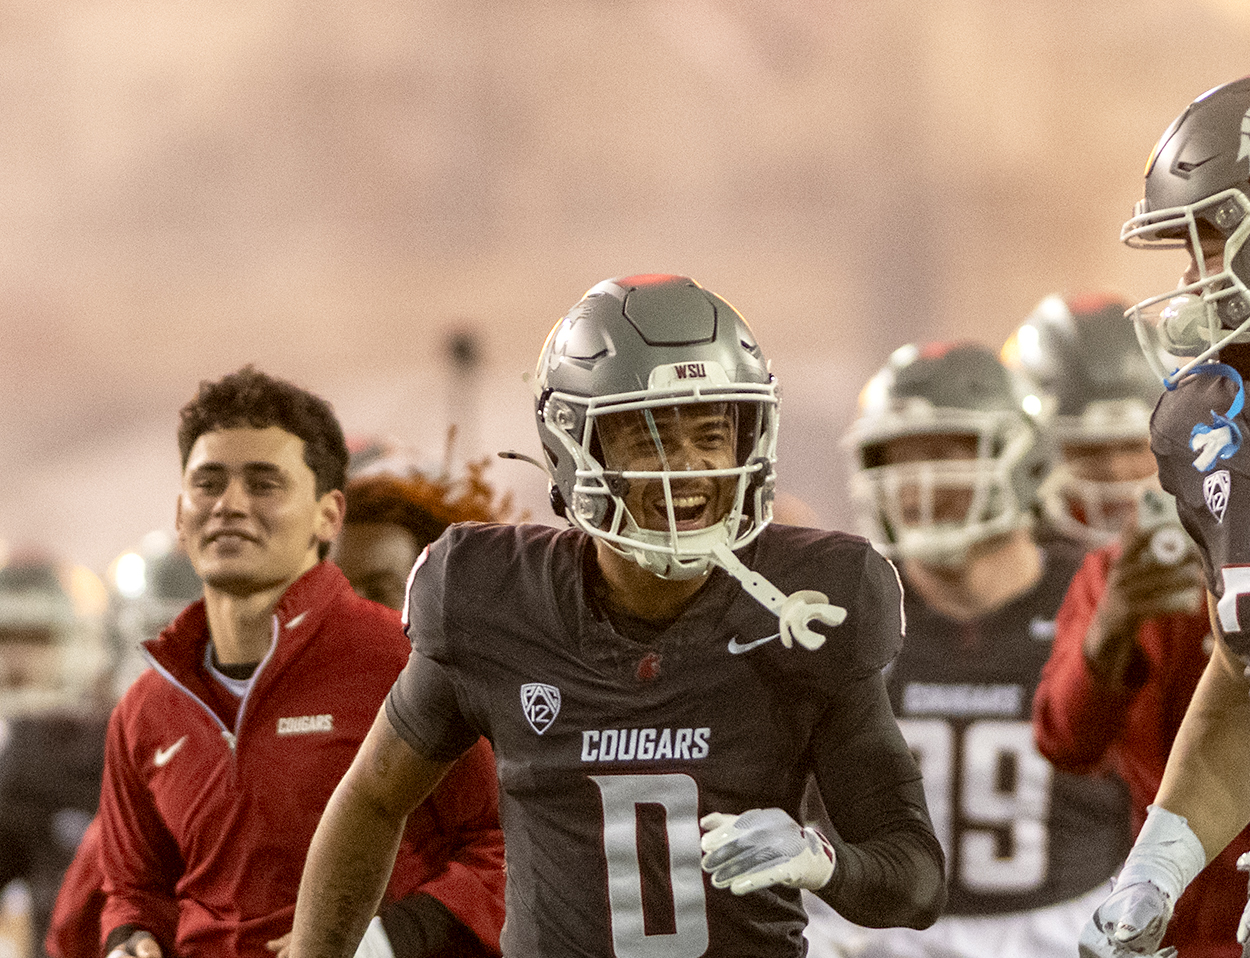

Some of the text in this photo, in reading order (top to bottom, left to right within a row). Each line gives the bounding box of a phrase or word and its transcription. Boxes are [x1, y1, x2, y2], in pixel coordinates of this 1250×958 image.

[674, 363, 707, 379] WSU
[531, 704, 550, 722] 12
[581, 727, 711, 762] COUGARS
